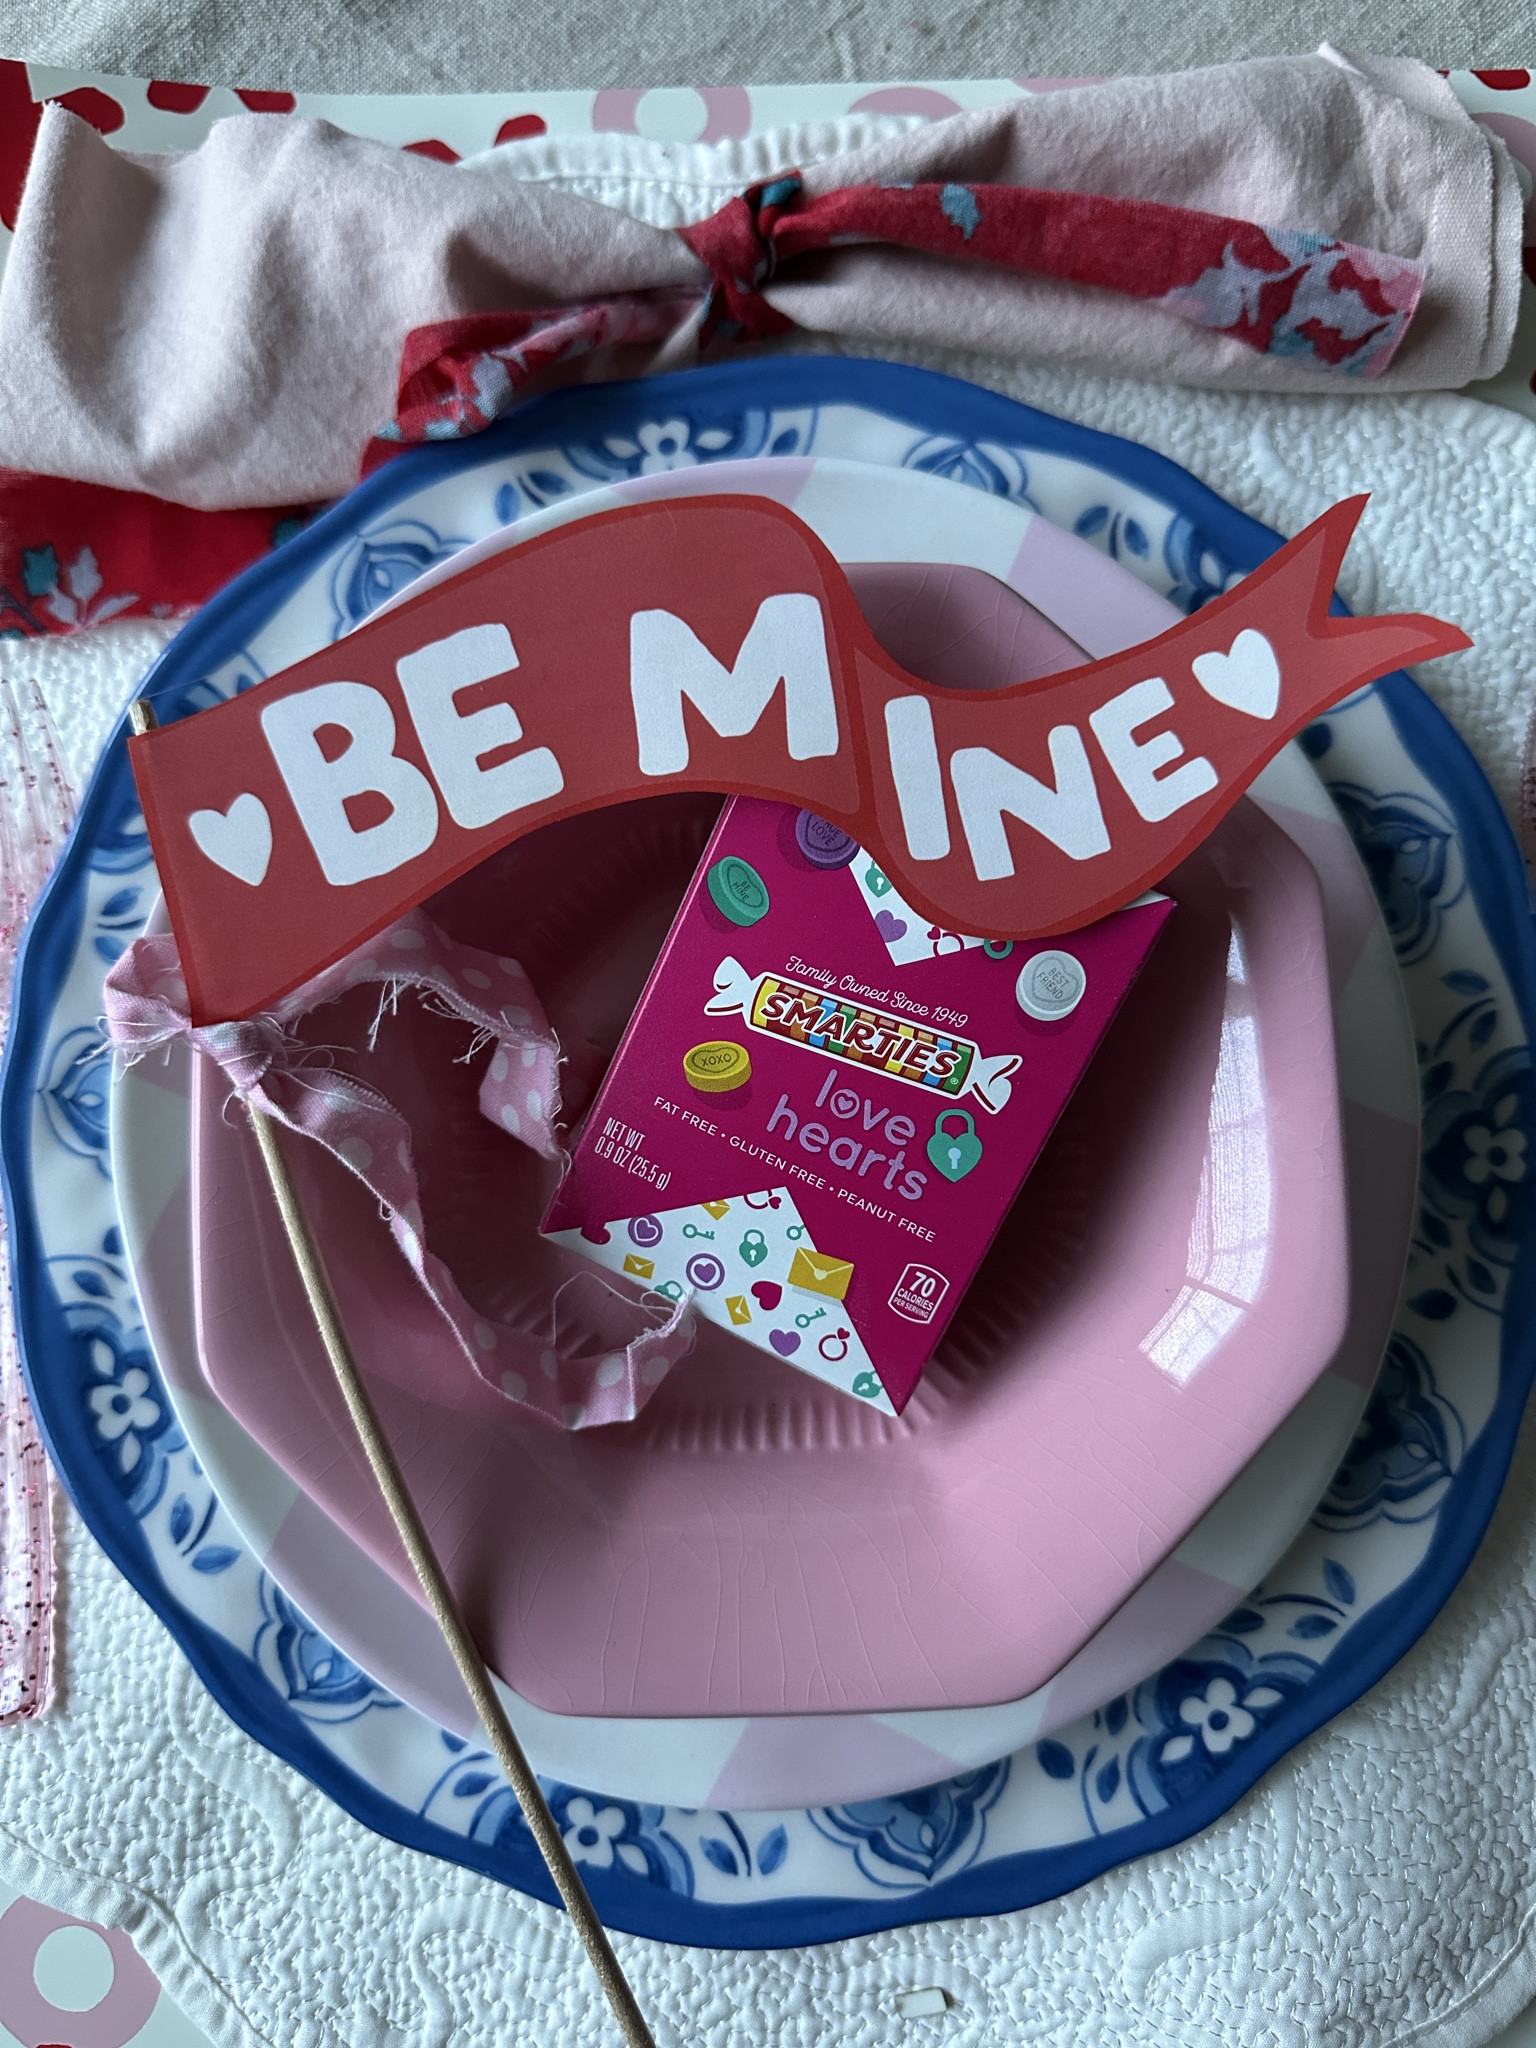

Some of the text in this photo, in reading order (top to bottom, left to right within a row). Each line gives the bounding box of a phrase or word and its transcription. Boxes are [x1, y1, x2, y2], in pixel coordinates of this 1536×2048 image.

[261, 592, 1219, 886] BE MINE
[811, 821, 836, 846] LOVE
[732, 881, 750, 900] MINE
[740, 880, 752, 892] BE
[785, 955, 969, 1028] Family Owned Since 1949
[1036, 971, 1064, 999] FRIEND
[1048, 967, 1070, 988] BEST
[759, 994, 962, 1077] SMARTIES
[701, 1053, 732, 1067] XOXO
[815, 1069, 916, 1146] love
[602, 1117, 646, 1151] NET WT
[766, 1093, 928, 1201] hearts
[594, 1136, 672, 1191] 0.9 OZ (25.5 g)
[654, 1096, 937, 1243] FAT FREE GLUTEN FREE PEANUT FREE
[910, 1271, 936, 1297] 70
[893, 1297, 929, 1319] PER SERVING
[897, 1287, 934, 1311] CALORIES
